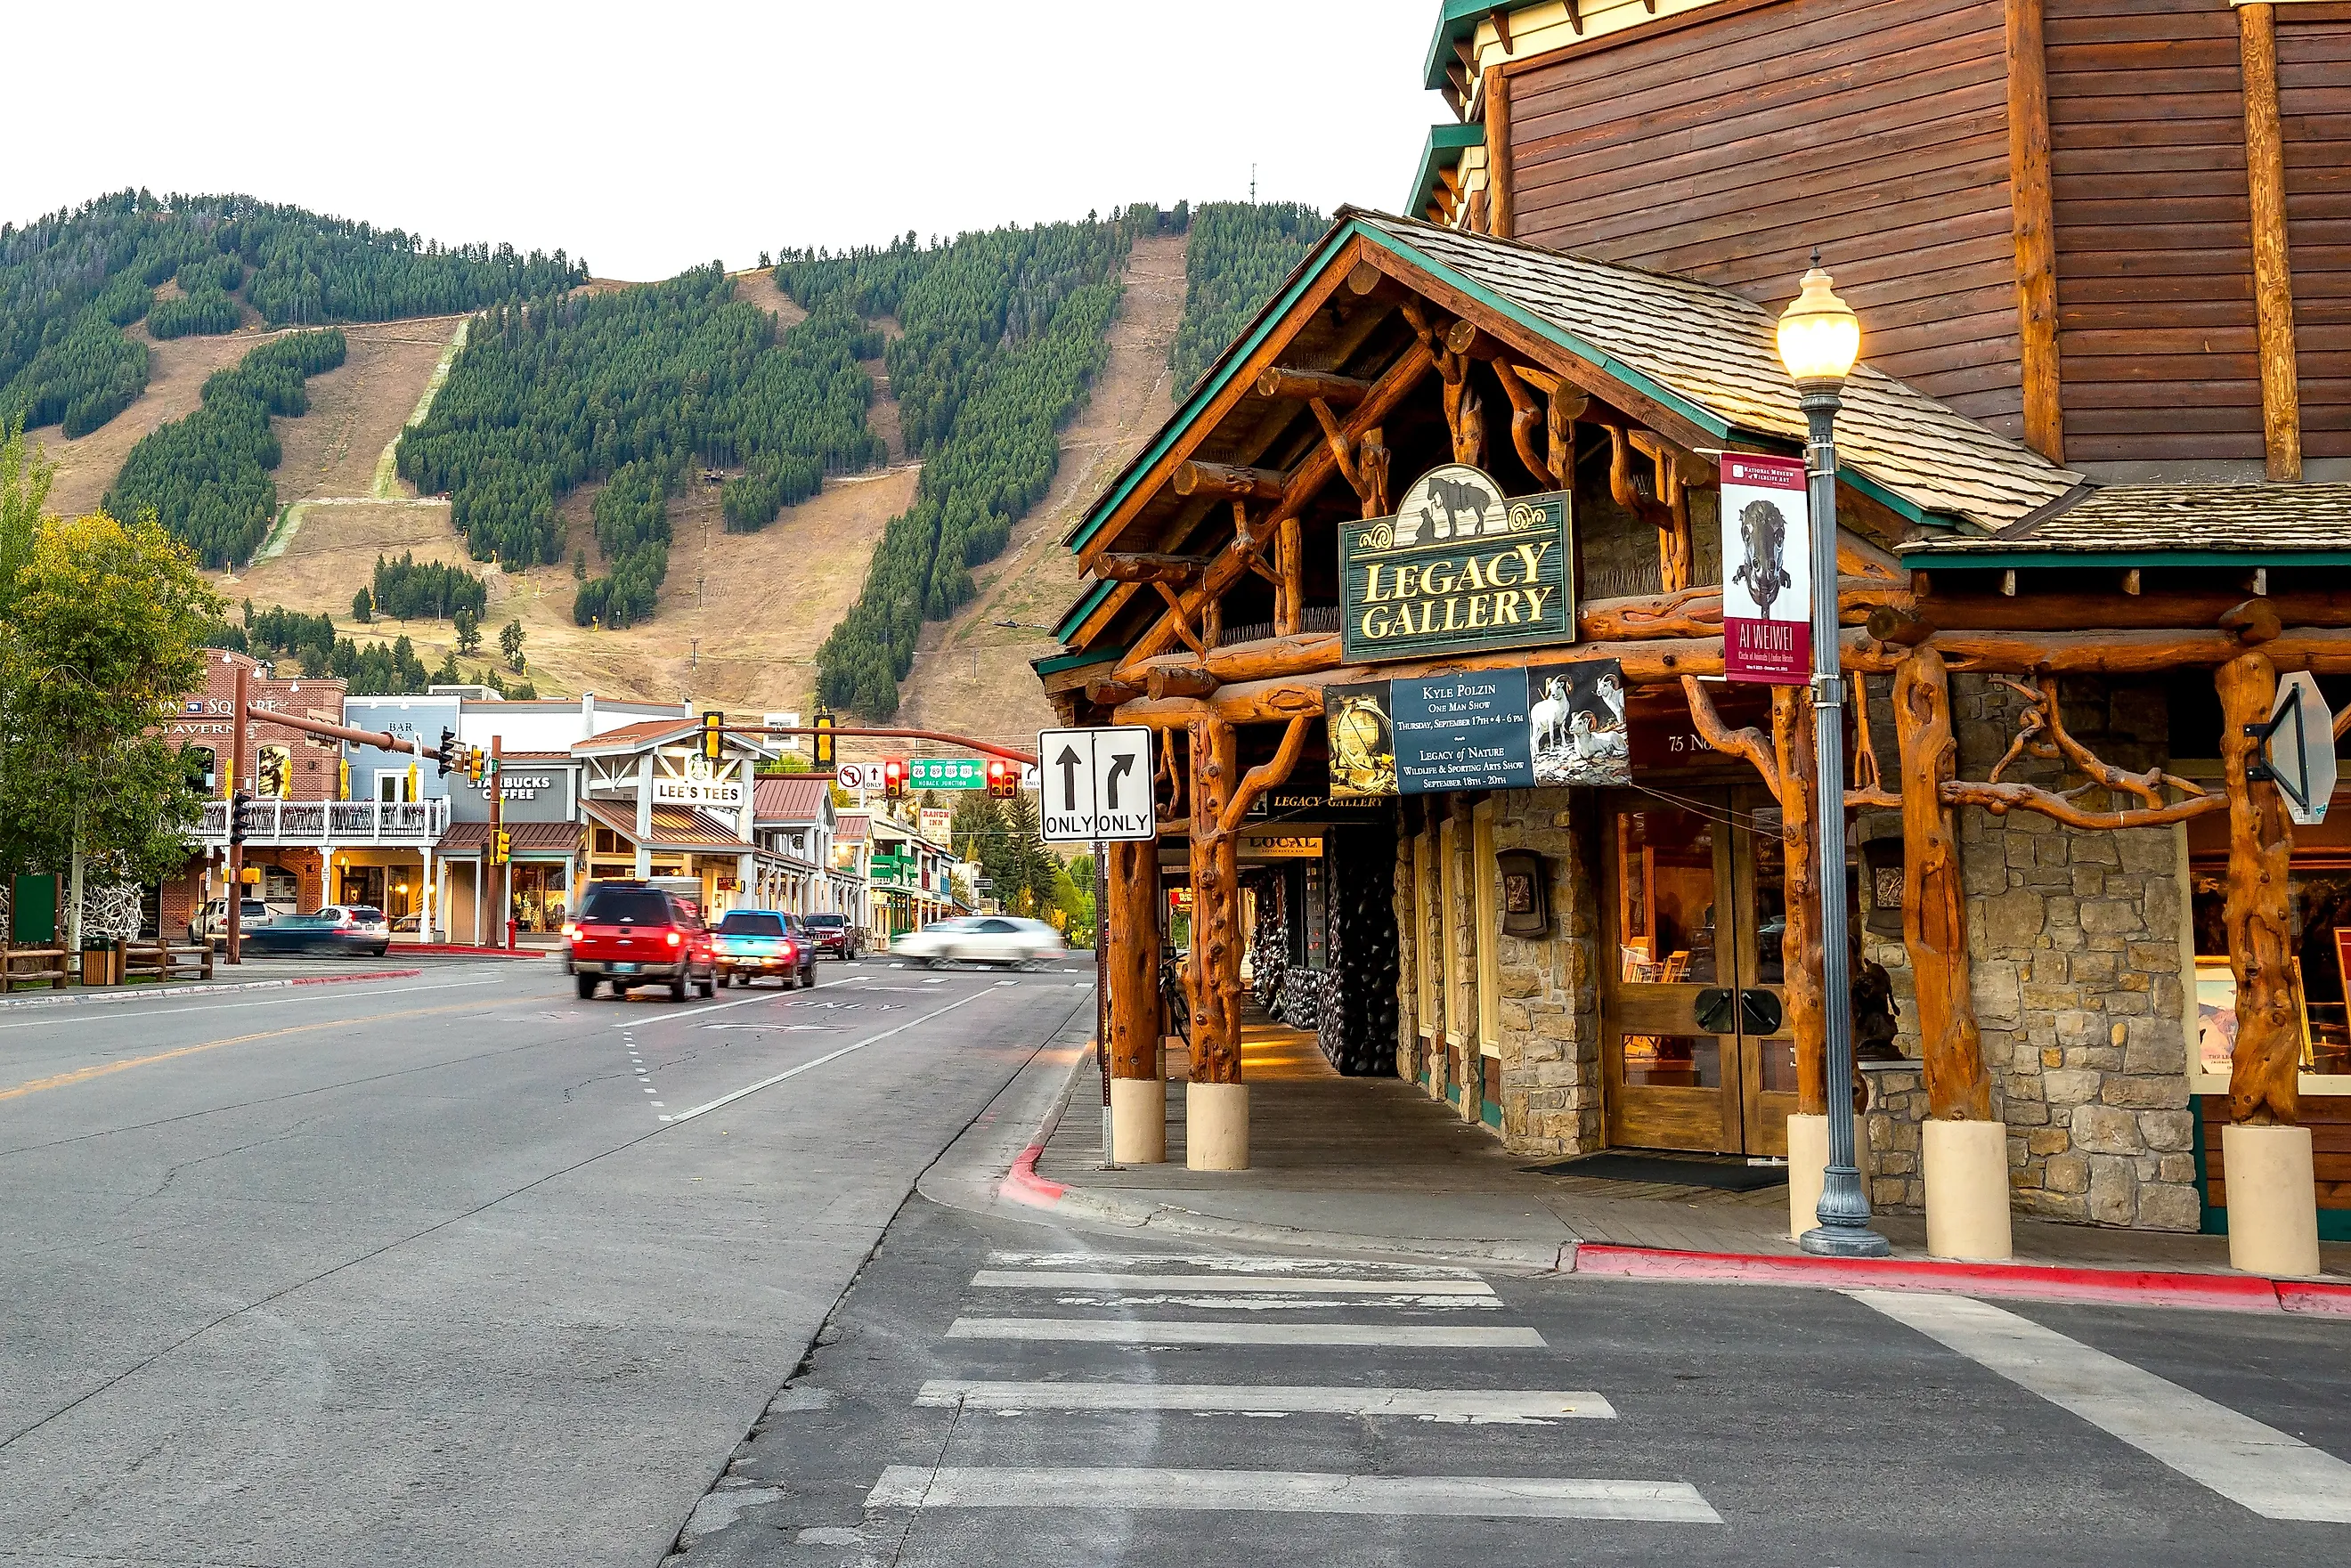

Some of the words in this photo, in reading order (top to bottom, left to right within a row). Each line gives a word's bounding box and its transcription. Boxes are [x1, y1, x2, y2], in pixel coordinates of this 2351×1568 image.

[1362, 541, 1553, 603] LEGACY
[1362, 586, 1554, 639] GALLERY
[1739, 623, 1750, 648] AI
[1753, 624, 1793, 651] WEIWEI
[1422, 687, 1453, 699] KYLE
[1456, 684, 1496, 697] POLZIN
[1428, 703, 1447, 713] ONE
[1448, 702, 1467, 711] MAN
[1468, 700, 1491, 711] SHOW
[388, 722, 413, 732] BAR
[1396, 721, 1434, 731] THURSDAY,
[1434, 718, 1470, 729] SEPTEMBER
[1471, 715, 1489, 726] 17TH
[1513, 715, 1524, 723] PM
[1669, 735, 1684, 752] 75
[1420, 750, 1453, 761] LEGACY
[1456, 748, 1466, 762] of
[1468, 747, 1505, 759] NATURE
[915, 768, 923, 776] 26
[931, 768, 940, 776] 89
[1403, 766, 1437, 776] WILDLIFE
[1438, 765, 1447, 774] &
[1447, 763, 1482, 774] SPORTING
[1483, 761, 1501, 771] ARTS
[1502, 760, 1525, 770] SHOW
[1423, 778, 1461, 788] SEPTEMBER
[1462, 776, 1481, 786] 18TH
[1487, 776, 1506, 785] 20TH
[482, 789, 535, 800] CFFEE
[660, 785, 698, 798] LEE'S
[703, 787, 738, 800] TEES
[1274, 796, 1322, 807] LEGACY
[923, 807, 949, 818] RANCH
[1046, 816, 1094, 833] ONLY
[1099, 814, 1149, 832] ONLY
[1249, 837, 1318, 848] LOCAL
[782, 1001, 907, 1011] ONLY
